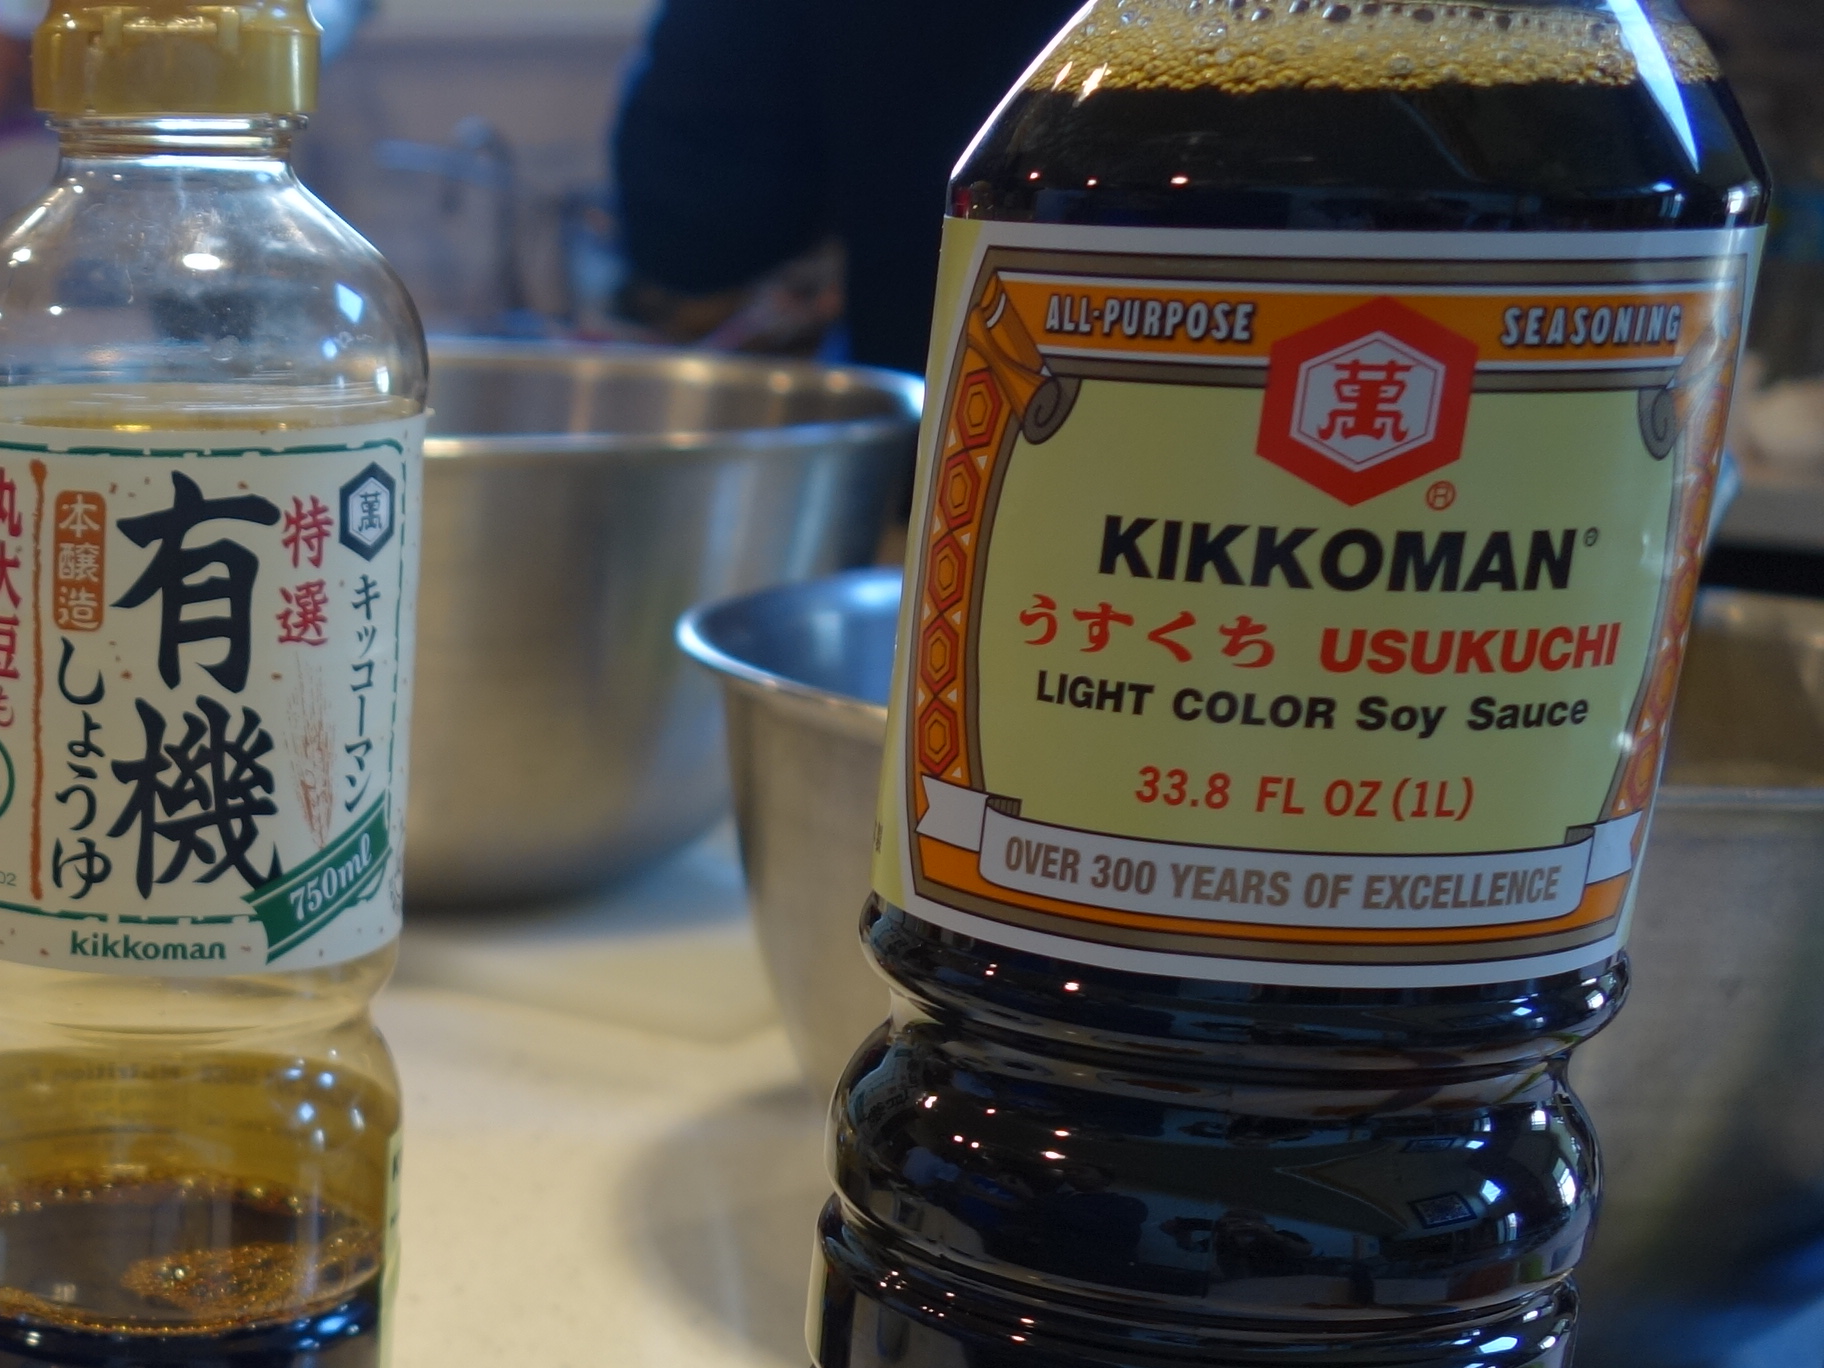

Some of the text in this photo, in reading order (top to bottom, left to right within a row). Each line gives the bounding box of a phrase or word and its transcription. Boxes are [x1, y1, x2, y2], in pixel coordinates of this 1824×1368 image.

[1044, 293, 1683, 347] ALL-PURPOSE SEASONING
[57, 493, 101, 630] 本醸造
[276, 495, 334, 648] 特選
[1097, 514, 1578, 592] KIKKOMAN
[1019, 593, 1622, 674] うすくち USUKUCHI
[107, 470, 283, 900] 有機
[344, 573, 381, 813] キッコーマン
[1036, 669, 1590, 739] LIGHT COLOR Soy Sauce
[52, 634, 113, 900] しょうゆ
[1134, 765, 1232, 810] 33.8
[1254, 775, 1306, 815] FL
[288, 832, 373, 921] 750ml
[1004, 835, 1563, 910] OVER 300 YEARS OF EXCELLENCE
[70, 930, 226, 961] kikkoman
